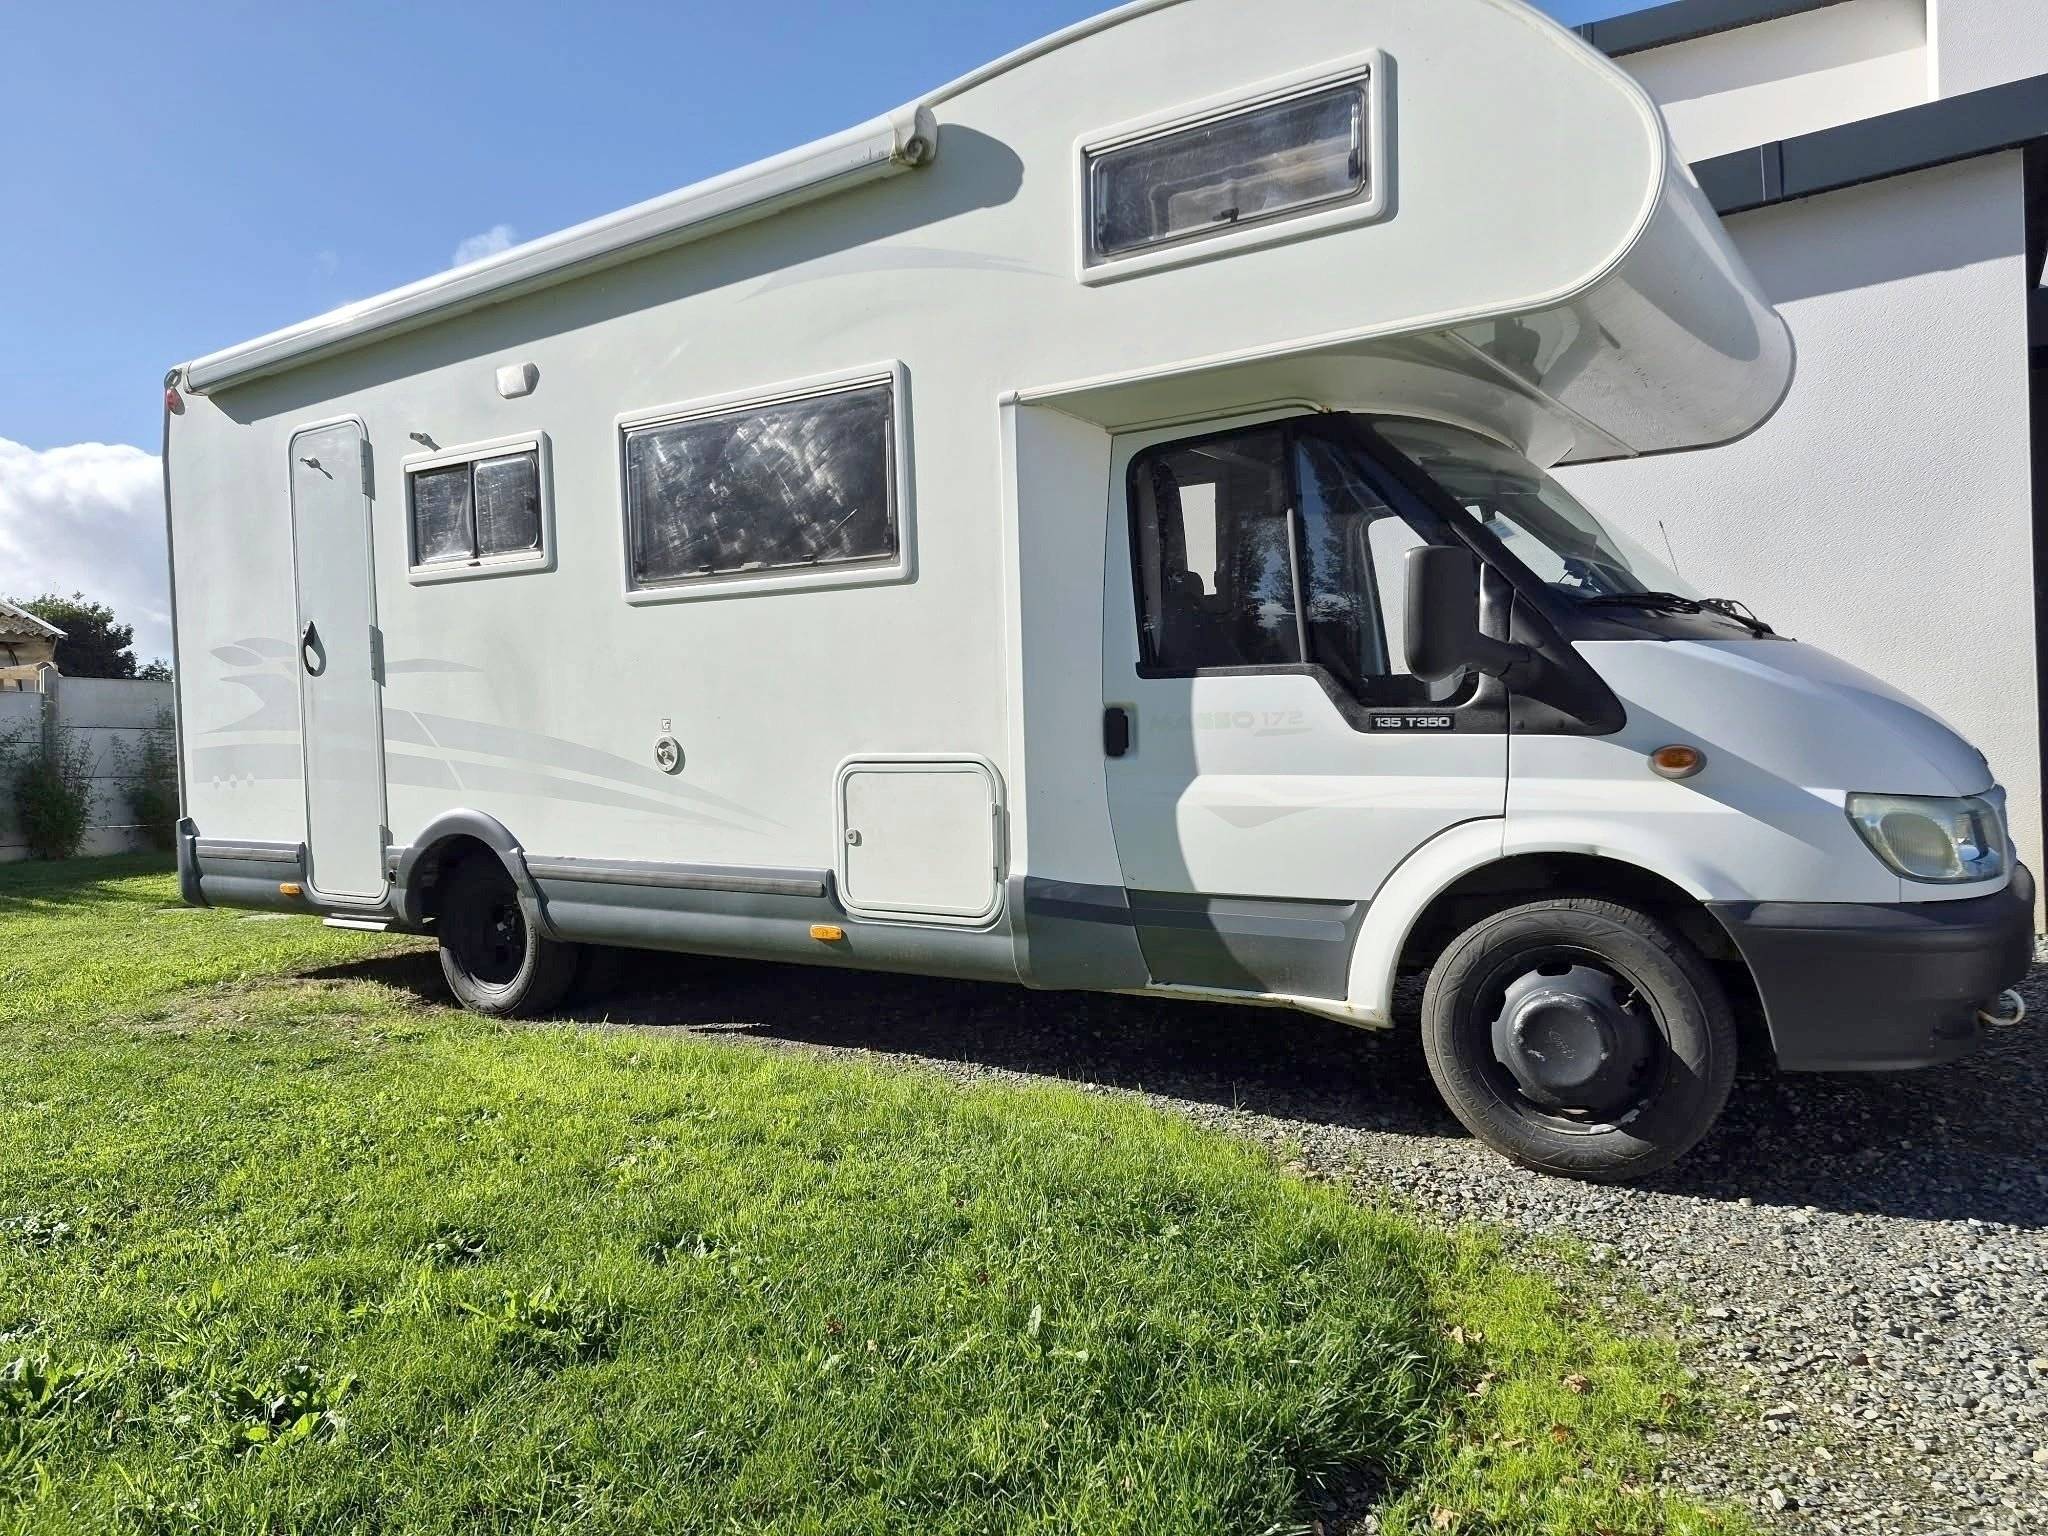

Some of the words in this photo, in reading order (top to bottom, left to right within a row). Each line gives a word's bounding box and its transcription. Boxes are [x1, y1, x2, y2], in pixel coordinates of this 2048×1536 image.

[1262, 710, 1305, 727] 172
[1375, 716, 1402, 728] 135
[1405, 716, 1451, 728] T350
